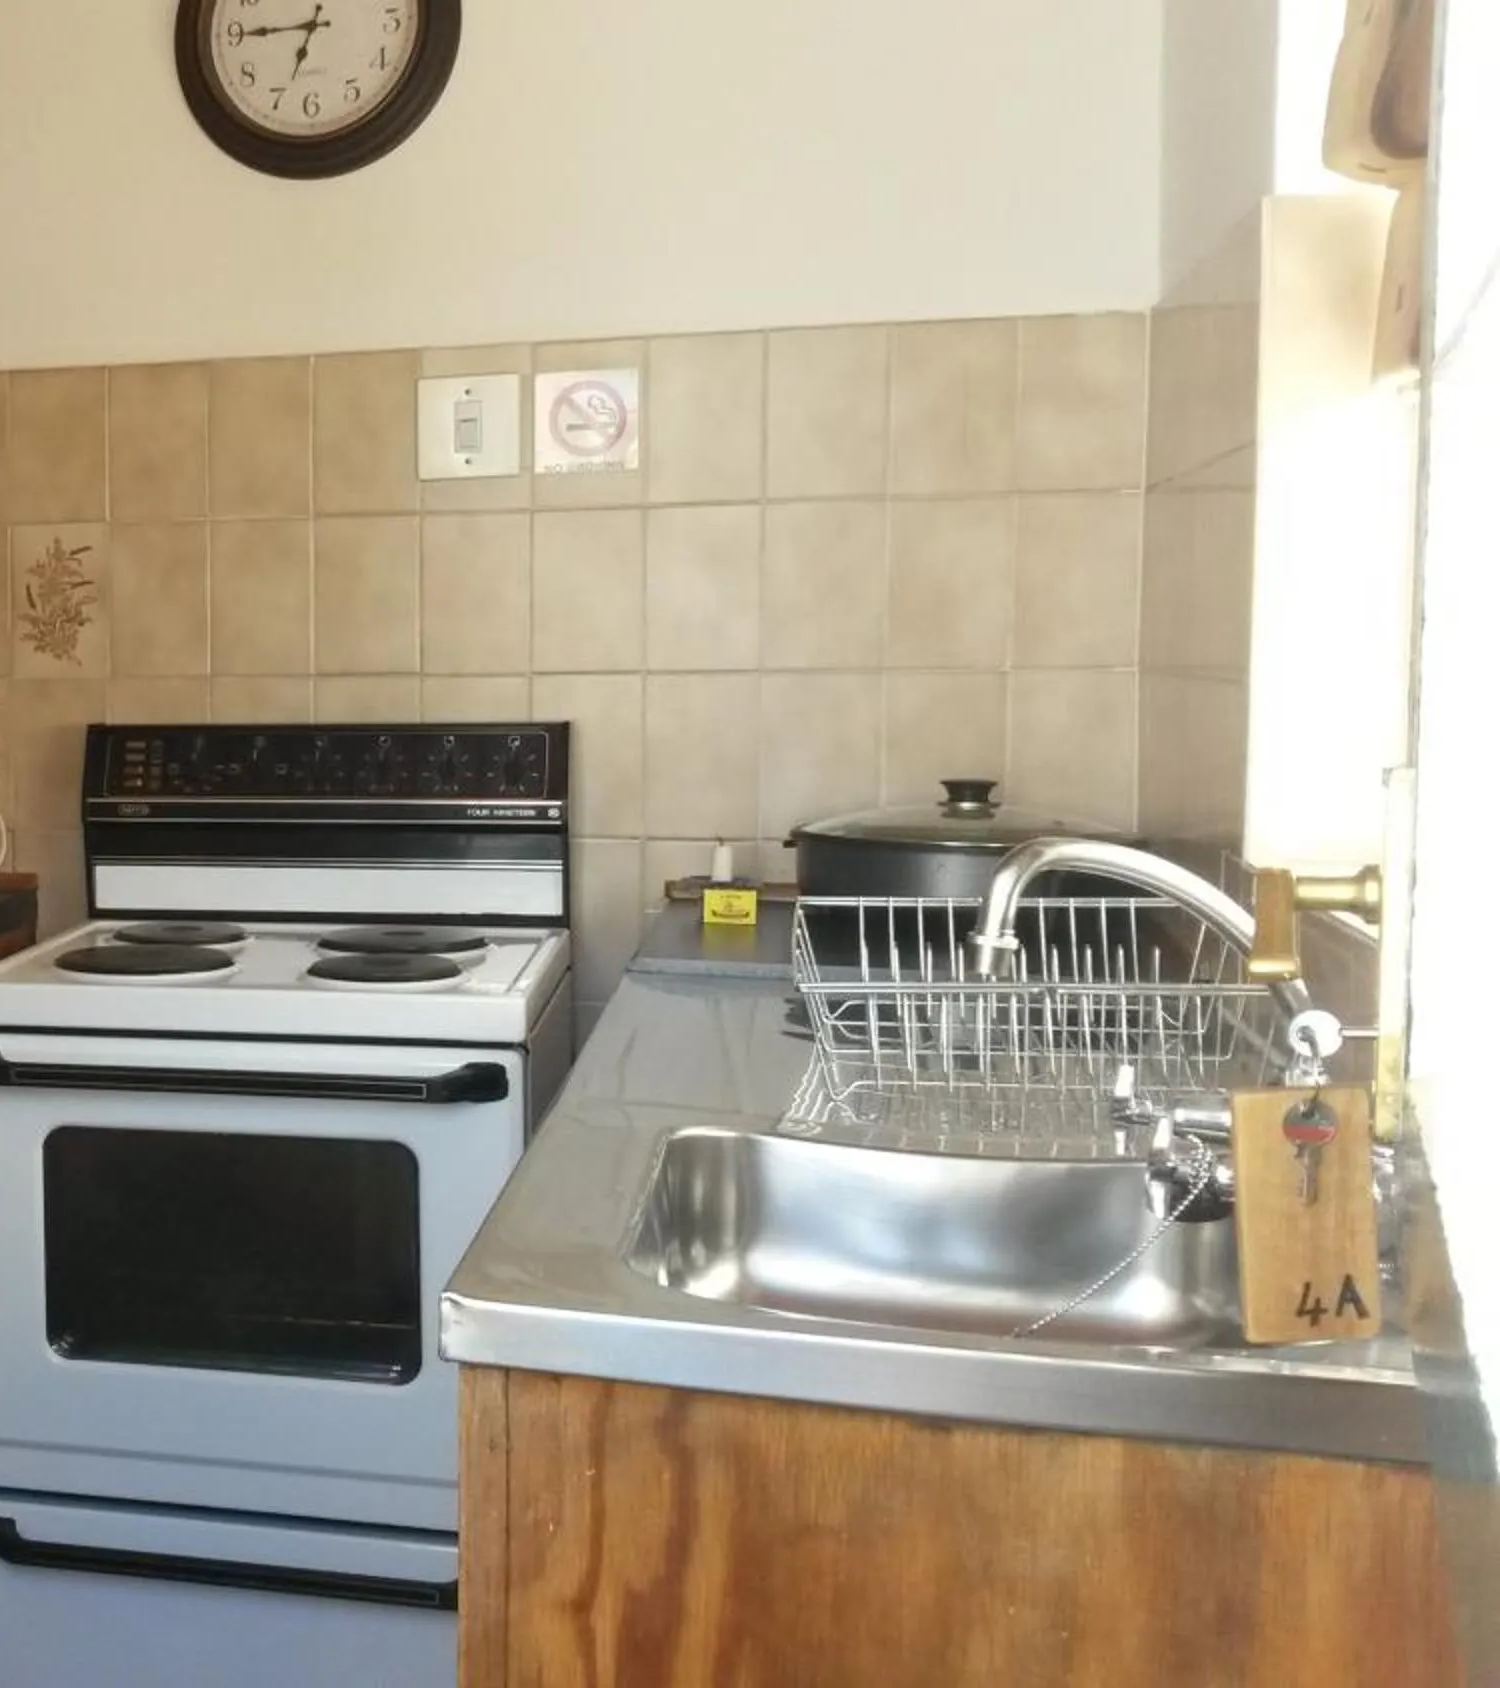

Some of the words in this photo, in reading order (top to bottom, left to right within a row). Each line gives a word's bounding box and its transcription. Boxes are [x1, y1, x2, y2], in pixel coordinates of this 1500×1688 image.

[228, 21, 243, 47] 9
[369, 46, 389, 70] 4
[240, 62, 256, 87] 8
[269, 87, 286, 110] 7
[343, 79, 361, 103] 5
[303, 92, 320, 118] 6
[1296, 1273, 1371, 1328] 4A
